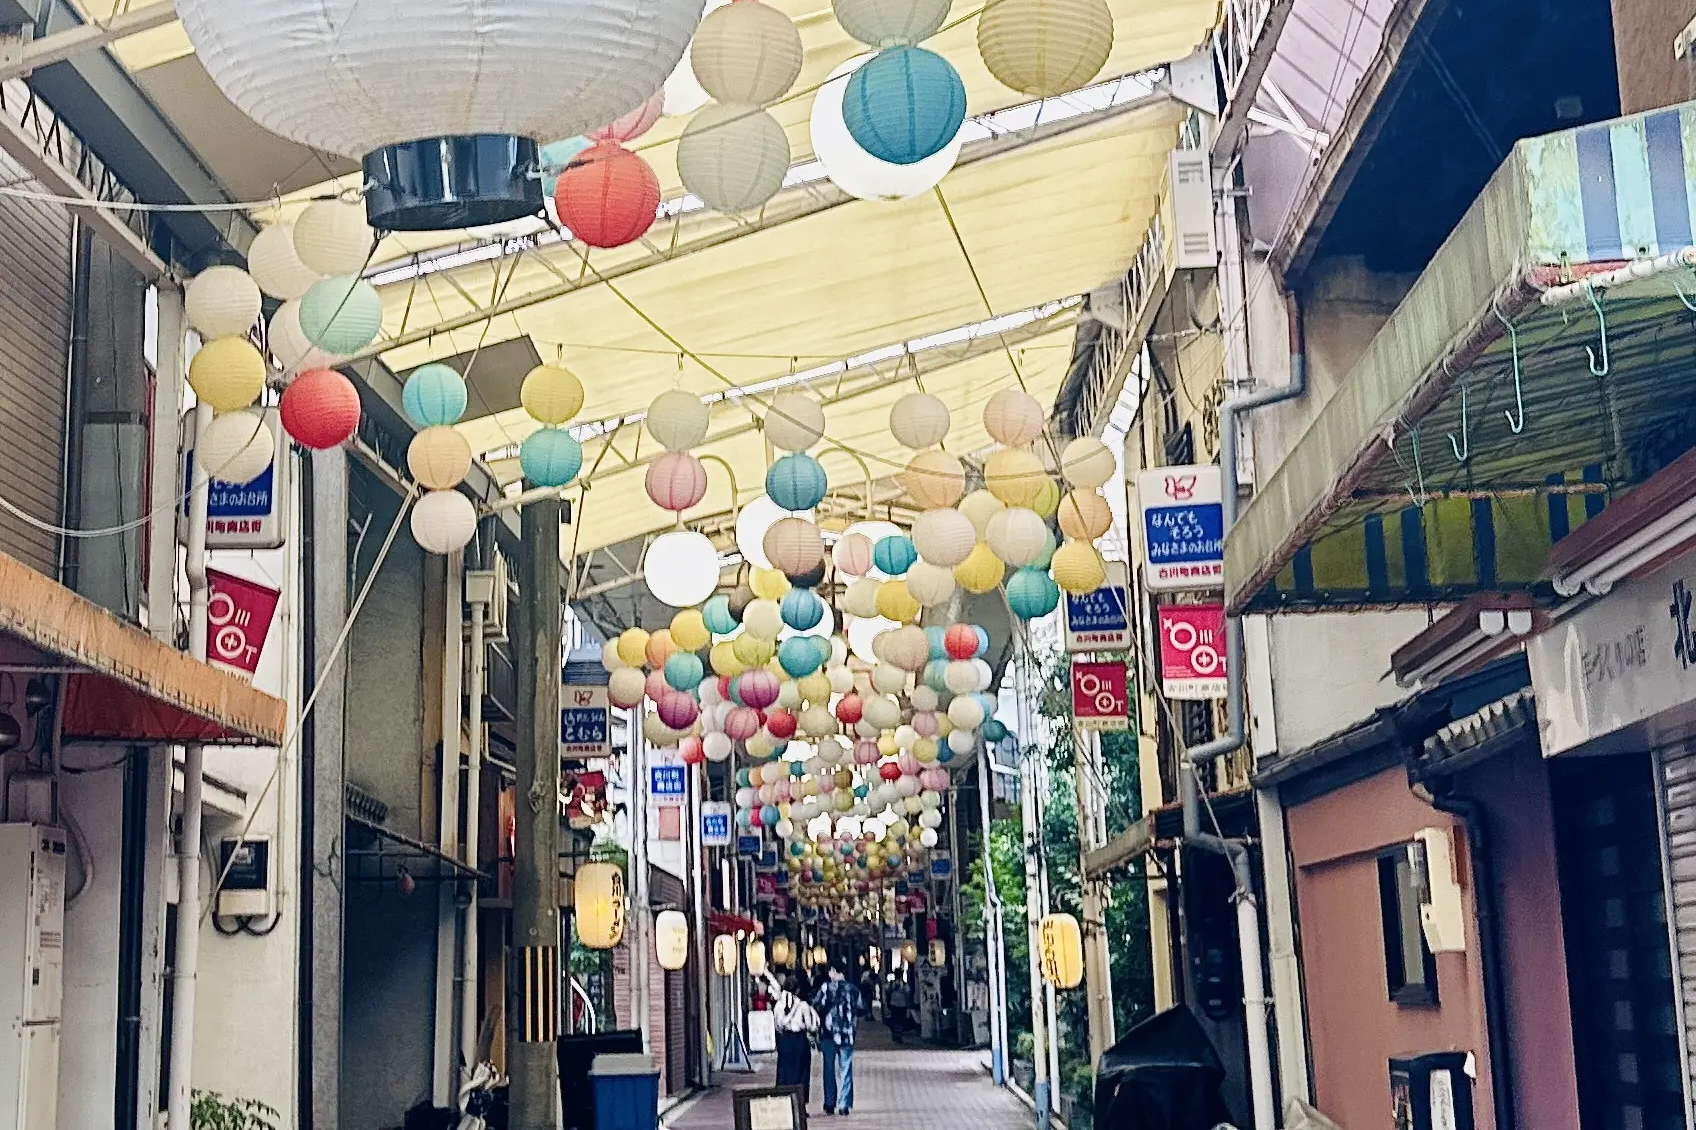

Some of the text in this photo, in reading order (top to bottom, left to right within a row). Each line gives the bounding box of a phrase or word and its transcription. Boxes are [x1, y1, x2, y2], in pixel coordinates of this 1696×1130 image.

[1151, 510, 1198, 527] なんでも
[1172, 526, 1204, 539] そろう
